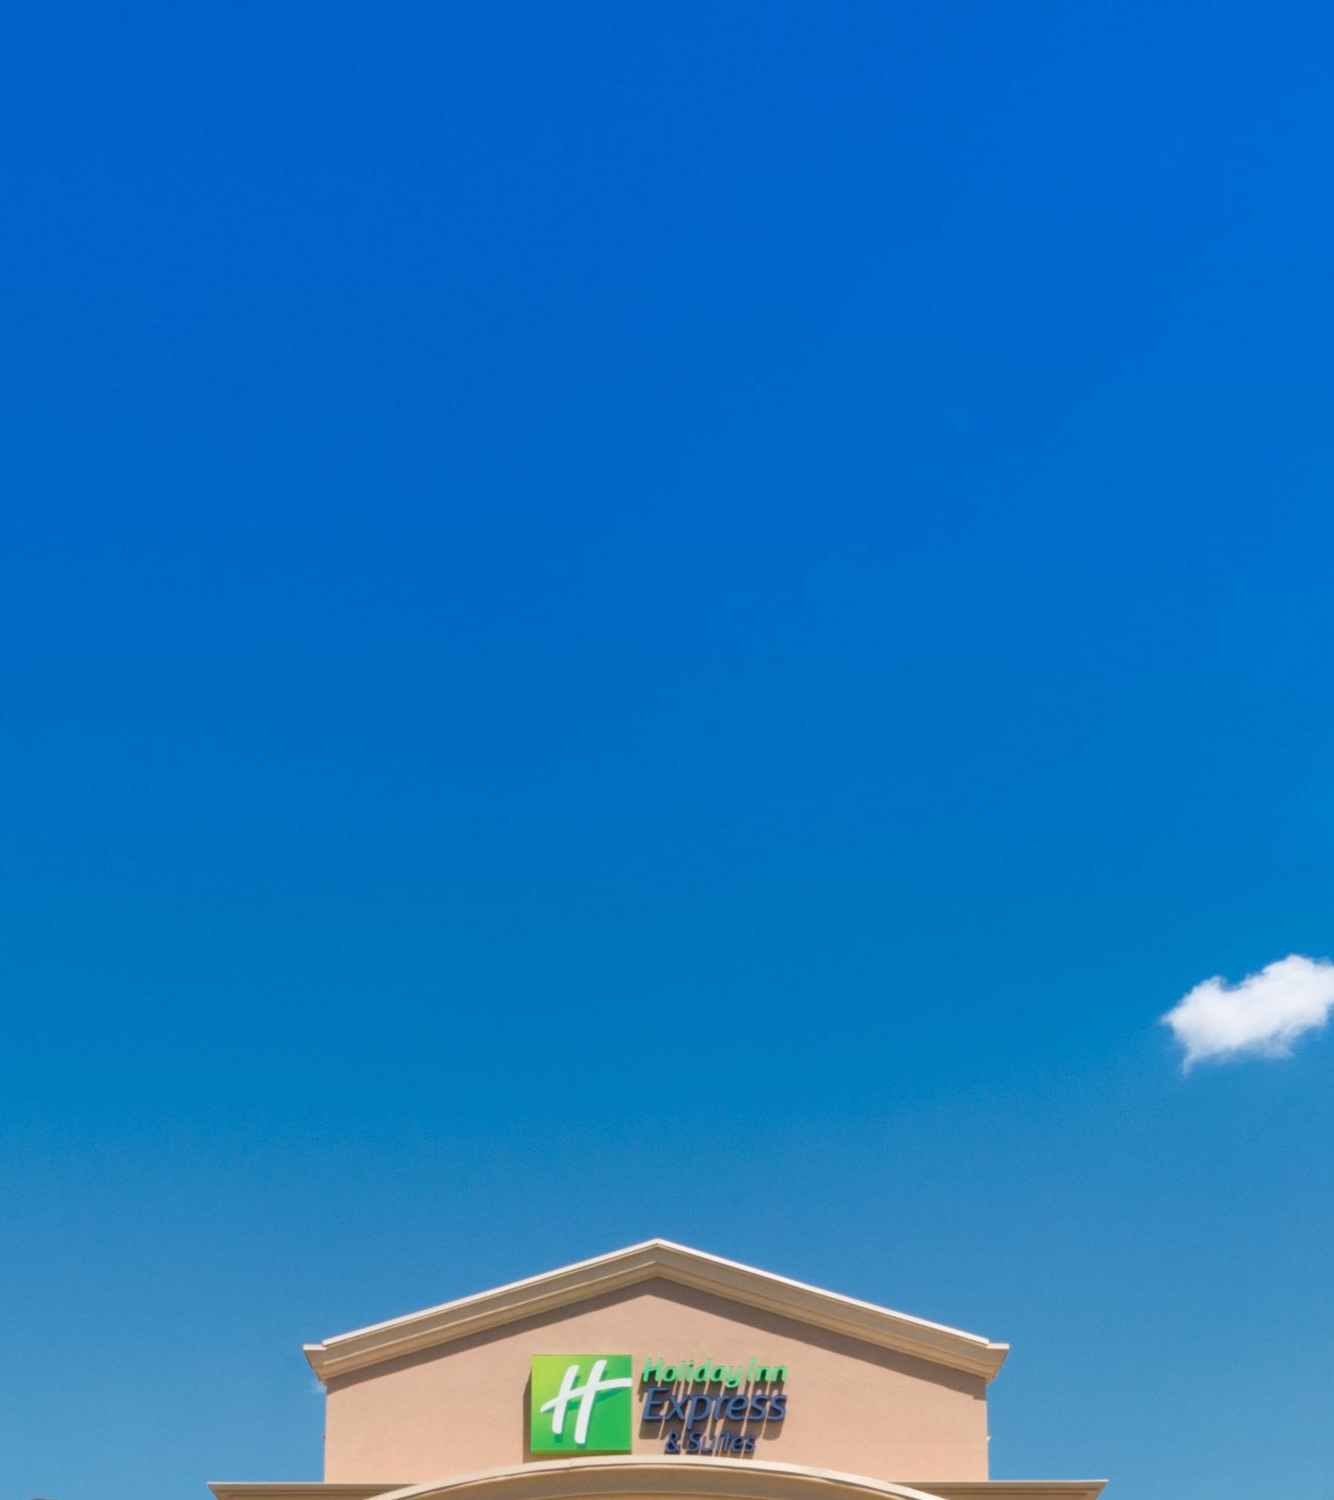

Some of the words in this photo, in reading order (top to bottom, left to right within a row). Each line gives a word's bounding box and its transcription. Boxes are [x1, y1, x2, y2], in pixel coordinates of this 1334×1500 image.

[642, 1358, 743, 1388] Holiday
[747, 1357, 788, 1382] Inn
[643, 1386, 787, 1430] Express
[665, 1431, 681, 1453] &
[686, 1430, 756, 1453] Suites
